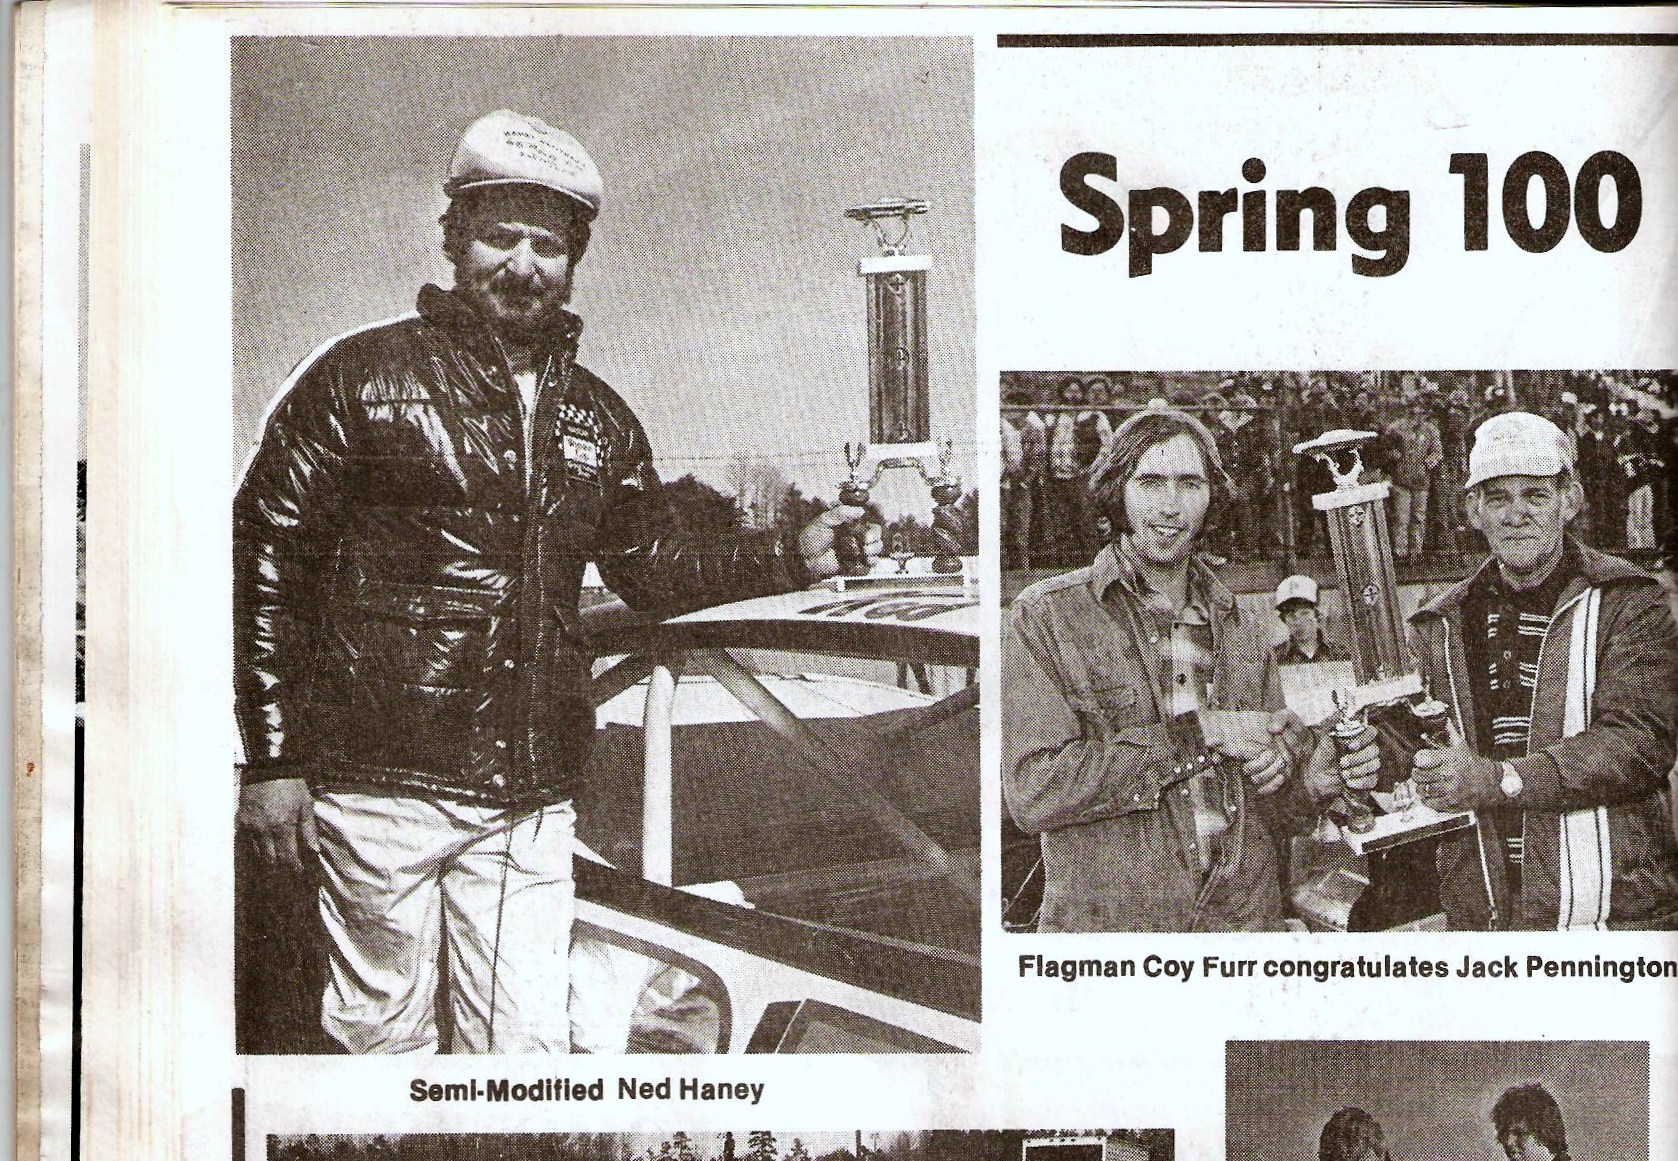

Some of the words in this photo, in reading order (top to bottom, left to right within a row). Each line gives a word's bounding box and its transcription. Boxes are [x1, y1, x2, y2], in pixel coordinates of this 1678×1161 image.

[1059, 151, 1411, 279] Spring
[1448, 149, 1643, 254] 100
[1018, 954, 1136, 983] Flagman
[1142, 954, 1195, 983] Coy
[1202, 956, 1258, 978] Furr
[1263, 954, 1449, 983] congratulates
[1456, 955, 1519, 979] Jack
[1526, 954, 1678, 984] Pennington
[409, 1077, 604, 1103] Semi-Modified
[618, 1076, 671, 1100] Ned
[679, 1077, 765, 1105] Haney
